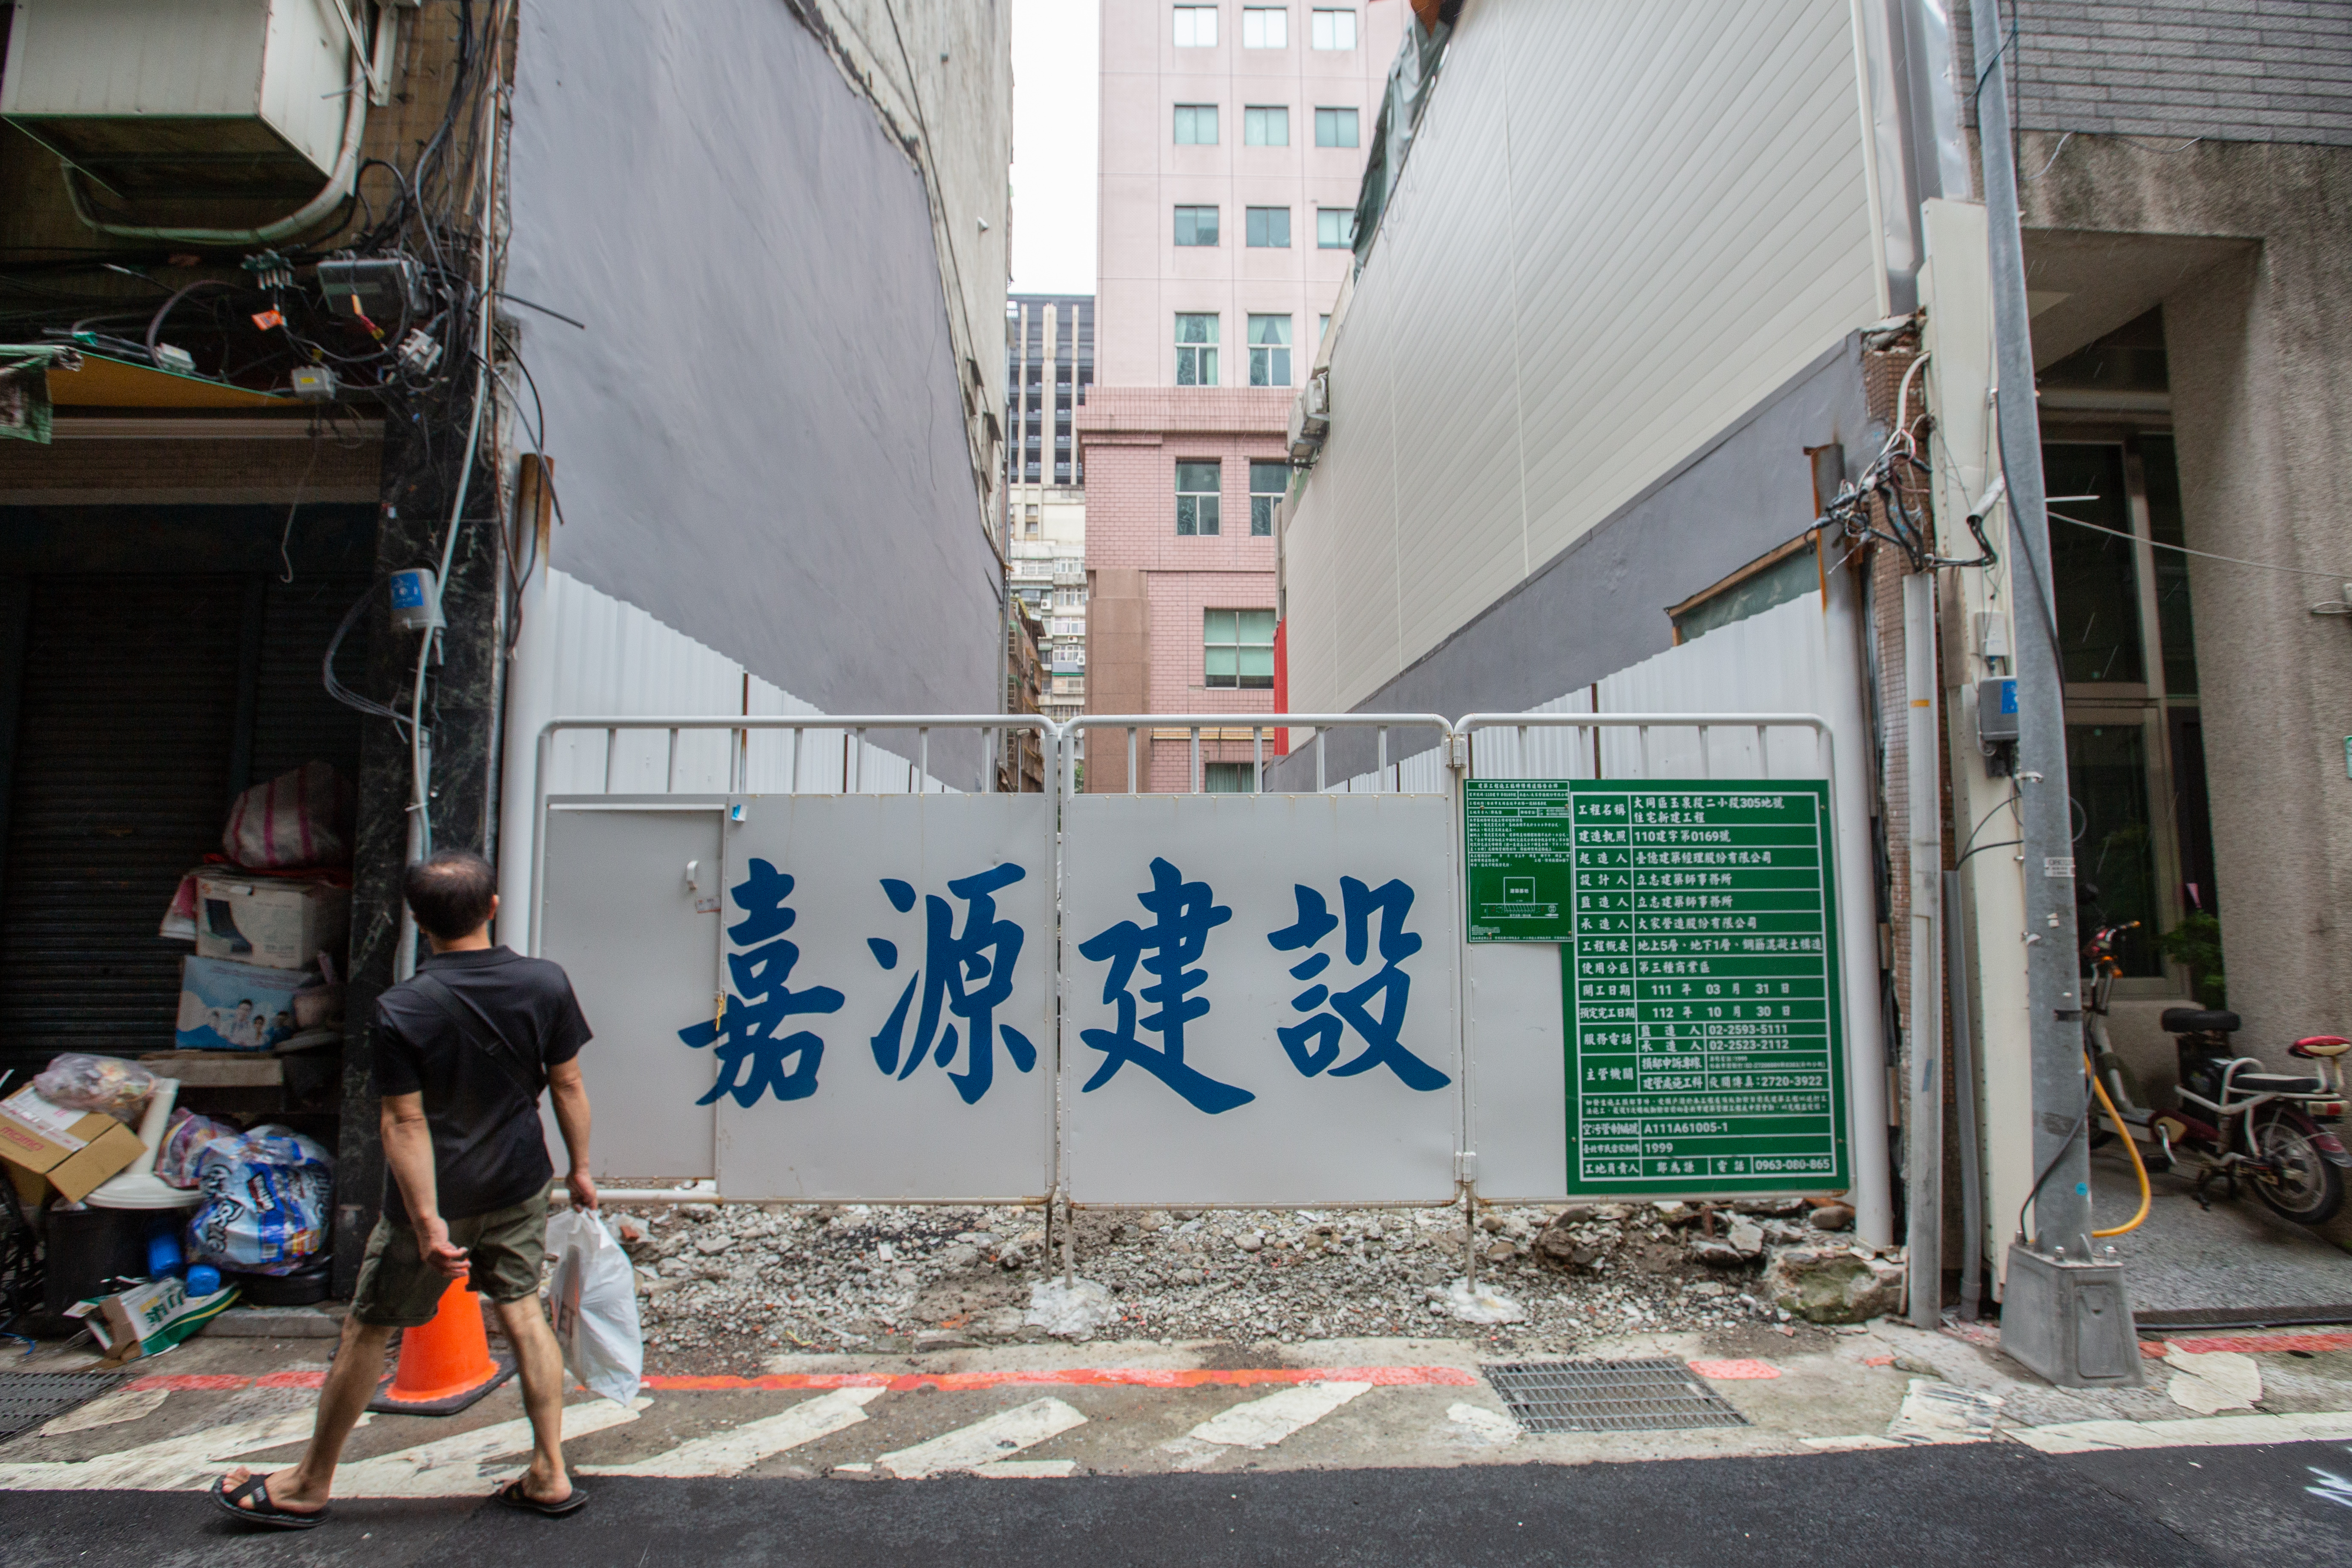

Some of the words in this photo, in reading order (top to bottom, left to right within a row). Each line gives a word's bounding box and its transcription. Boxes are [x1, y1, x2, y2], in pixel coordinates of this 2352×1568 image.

[1634, 797, 1785, 809] 大同區玉泉段二小段305地號
[1579, 804, 1626, 816] 工程名稱
[1634, 811, 1705, 823] 住宅新建工程
[1579, 830, 1626, 842] 建造執照
[1635, 829, 1731, 843] 110建字第0169號
[1580, 852, 1627, 865] 起造人
[1636, 851, 1772, 864] 臺億建築經理股份有限公司
[1580, 874, 1628, 886] 設計人
[1637, 873, 1732, 886] 立志建築師事務所
[1581, 896, 1629, 909] 監造人
[1637, 895, 1733, 908] 立志建築師事務所
[1581, 918, 1629, 930] 承造人
[1638, 916, 1757, 930] 大家營造股份有限公司
[1582, 940, 1629, 952] 工程概要
[1582, 961, 1629, 975] 使用分區
[1639, 961, 1710, 974] 第三種商業區
[678, 857, 1452, 1114] 嘉源建設
[1583, 984, 1630, 996] 開工日期
[1652, 985, 1672, 995] 111
[1681, 984, 1692, 996] 年
[1706, 984, 1721, 995] 03
[1755, 983, 1769, 994] 31
[1580, 1007, 1635, 1019] 預定完工日期
[1653, 1007, 1674, 1018] 112
[1682, 1006, 1693, 1018] 年
[1708, 1007, 1722, 1018] 10
[1757, 1006, 1771, 1017] 30
[1641, 1024, 1701, 1037] 監造人
[1708, 1024, 1788, 1035] 02-2593-5111
[1584, 1033, 1632, 1045] 服務電話
[1709, 1039, 1789, 1050] 02-2523-2112
[1641, 1040, 1702, 1052] 承造人
[1587, 1067, 1633, 1081] 主管機關
[1643, 1076, 1703, 1090] 建管處施工科
[1645, 1122, 1728, 1134] A111A61005-1
[1645, 1142, 1673, 1153] 1999
[1585, 1162, 1639, 1175] 工地負責人
[1717, 1160, 1744, 1173] 電話
